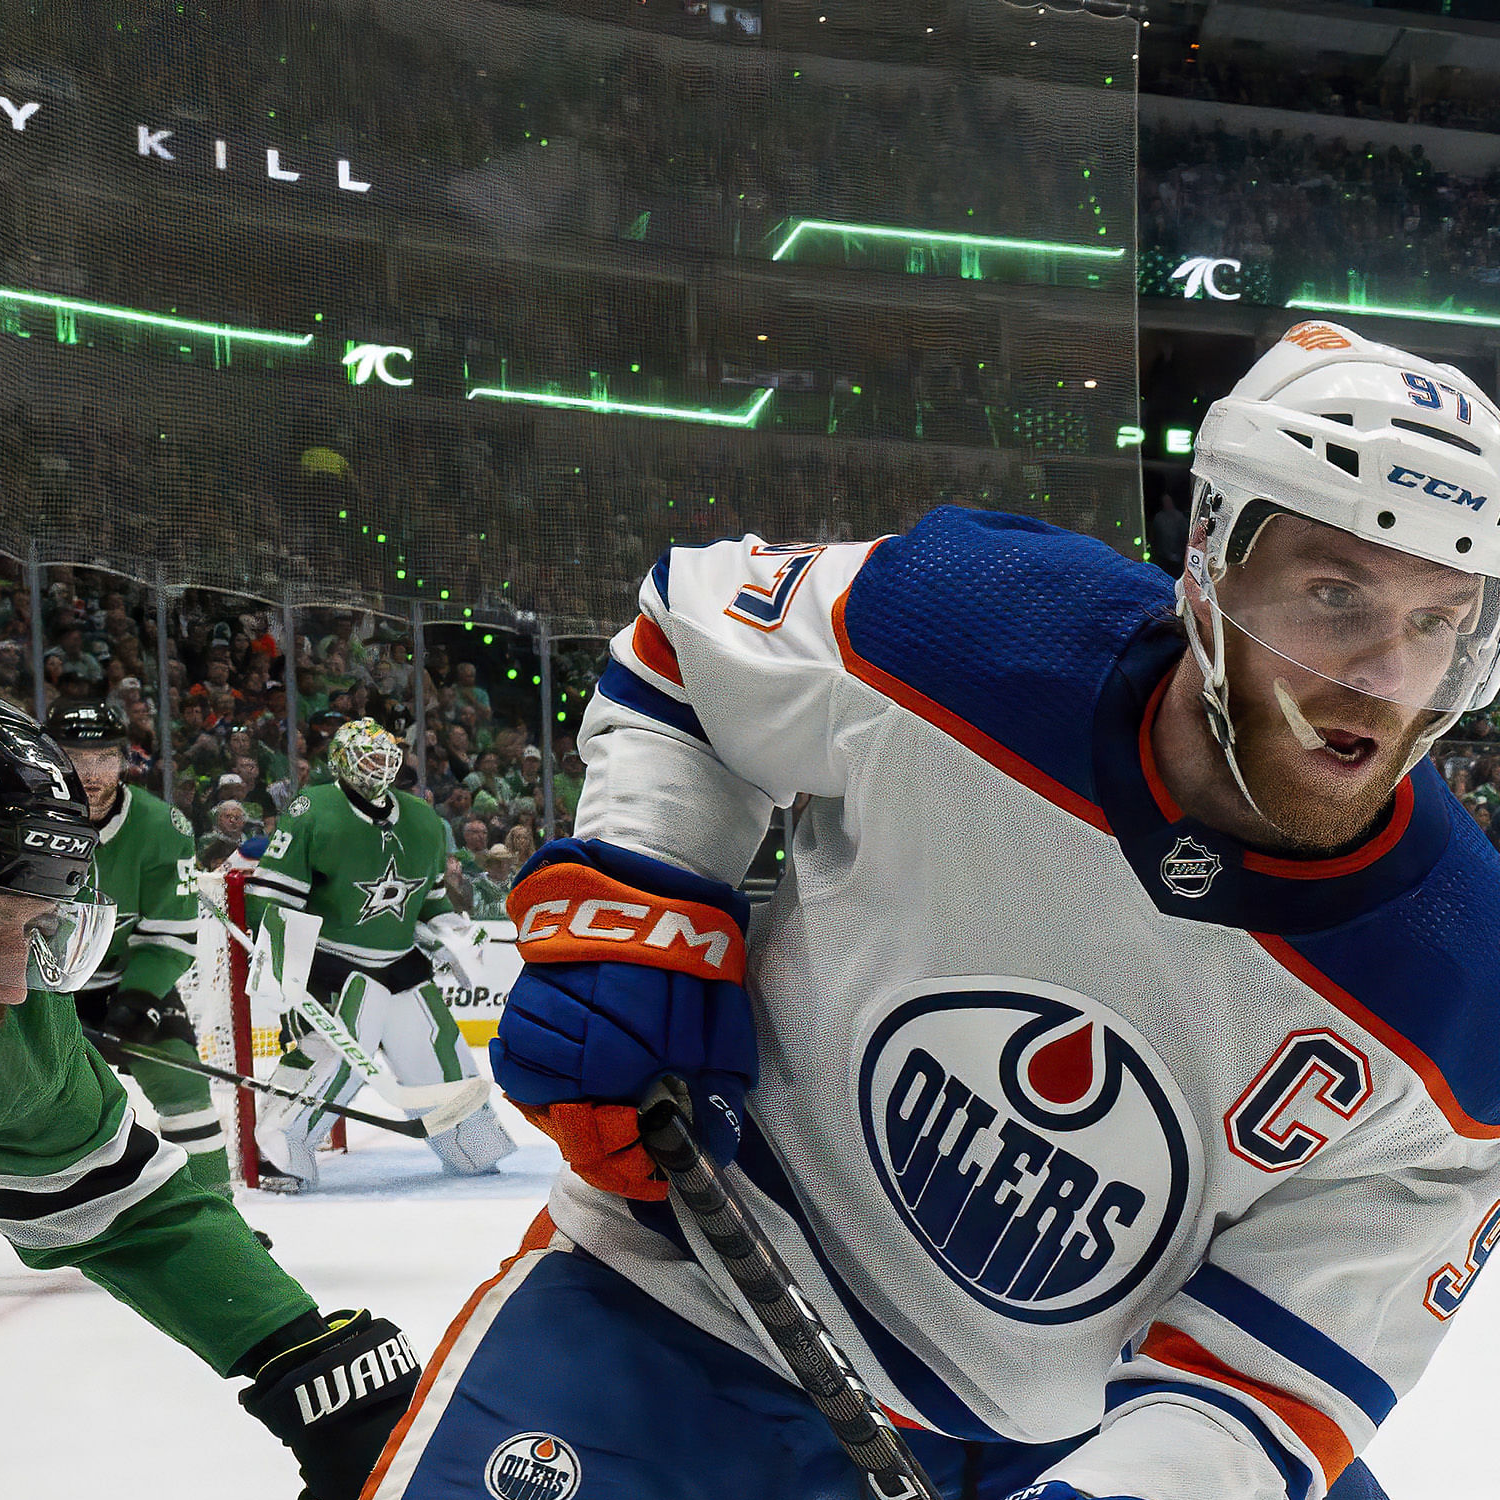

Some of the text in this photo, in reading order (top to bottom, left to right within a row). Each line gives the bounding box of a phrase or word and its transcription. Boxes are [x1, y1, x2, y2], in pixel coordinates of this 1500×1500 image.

[137, 124, 372, 193] KILL
[1400, 371, 1472, 426] 97
[1386, 463, 1489, 513] CCM
[23, 829, 94, 856] CCM
[515, 898, 731, 970] CCM
[301, 1001, 380, 1077] BAUER
[1223, 1026, 1374, 1174] C
[884, 1046, 1147, 1303] OILERS
